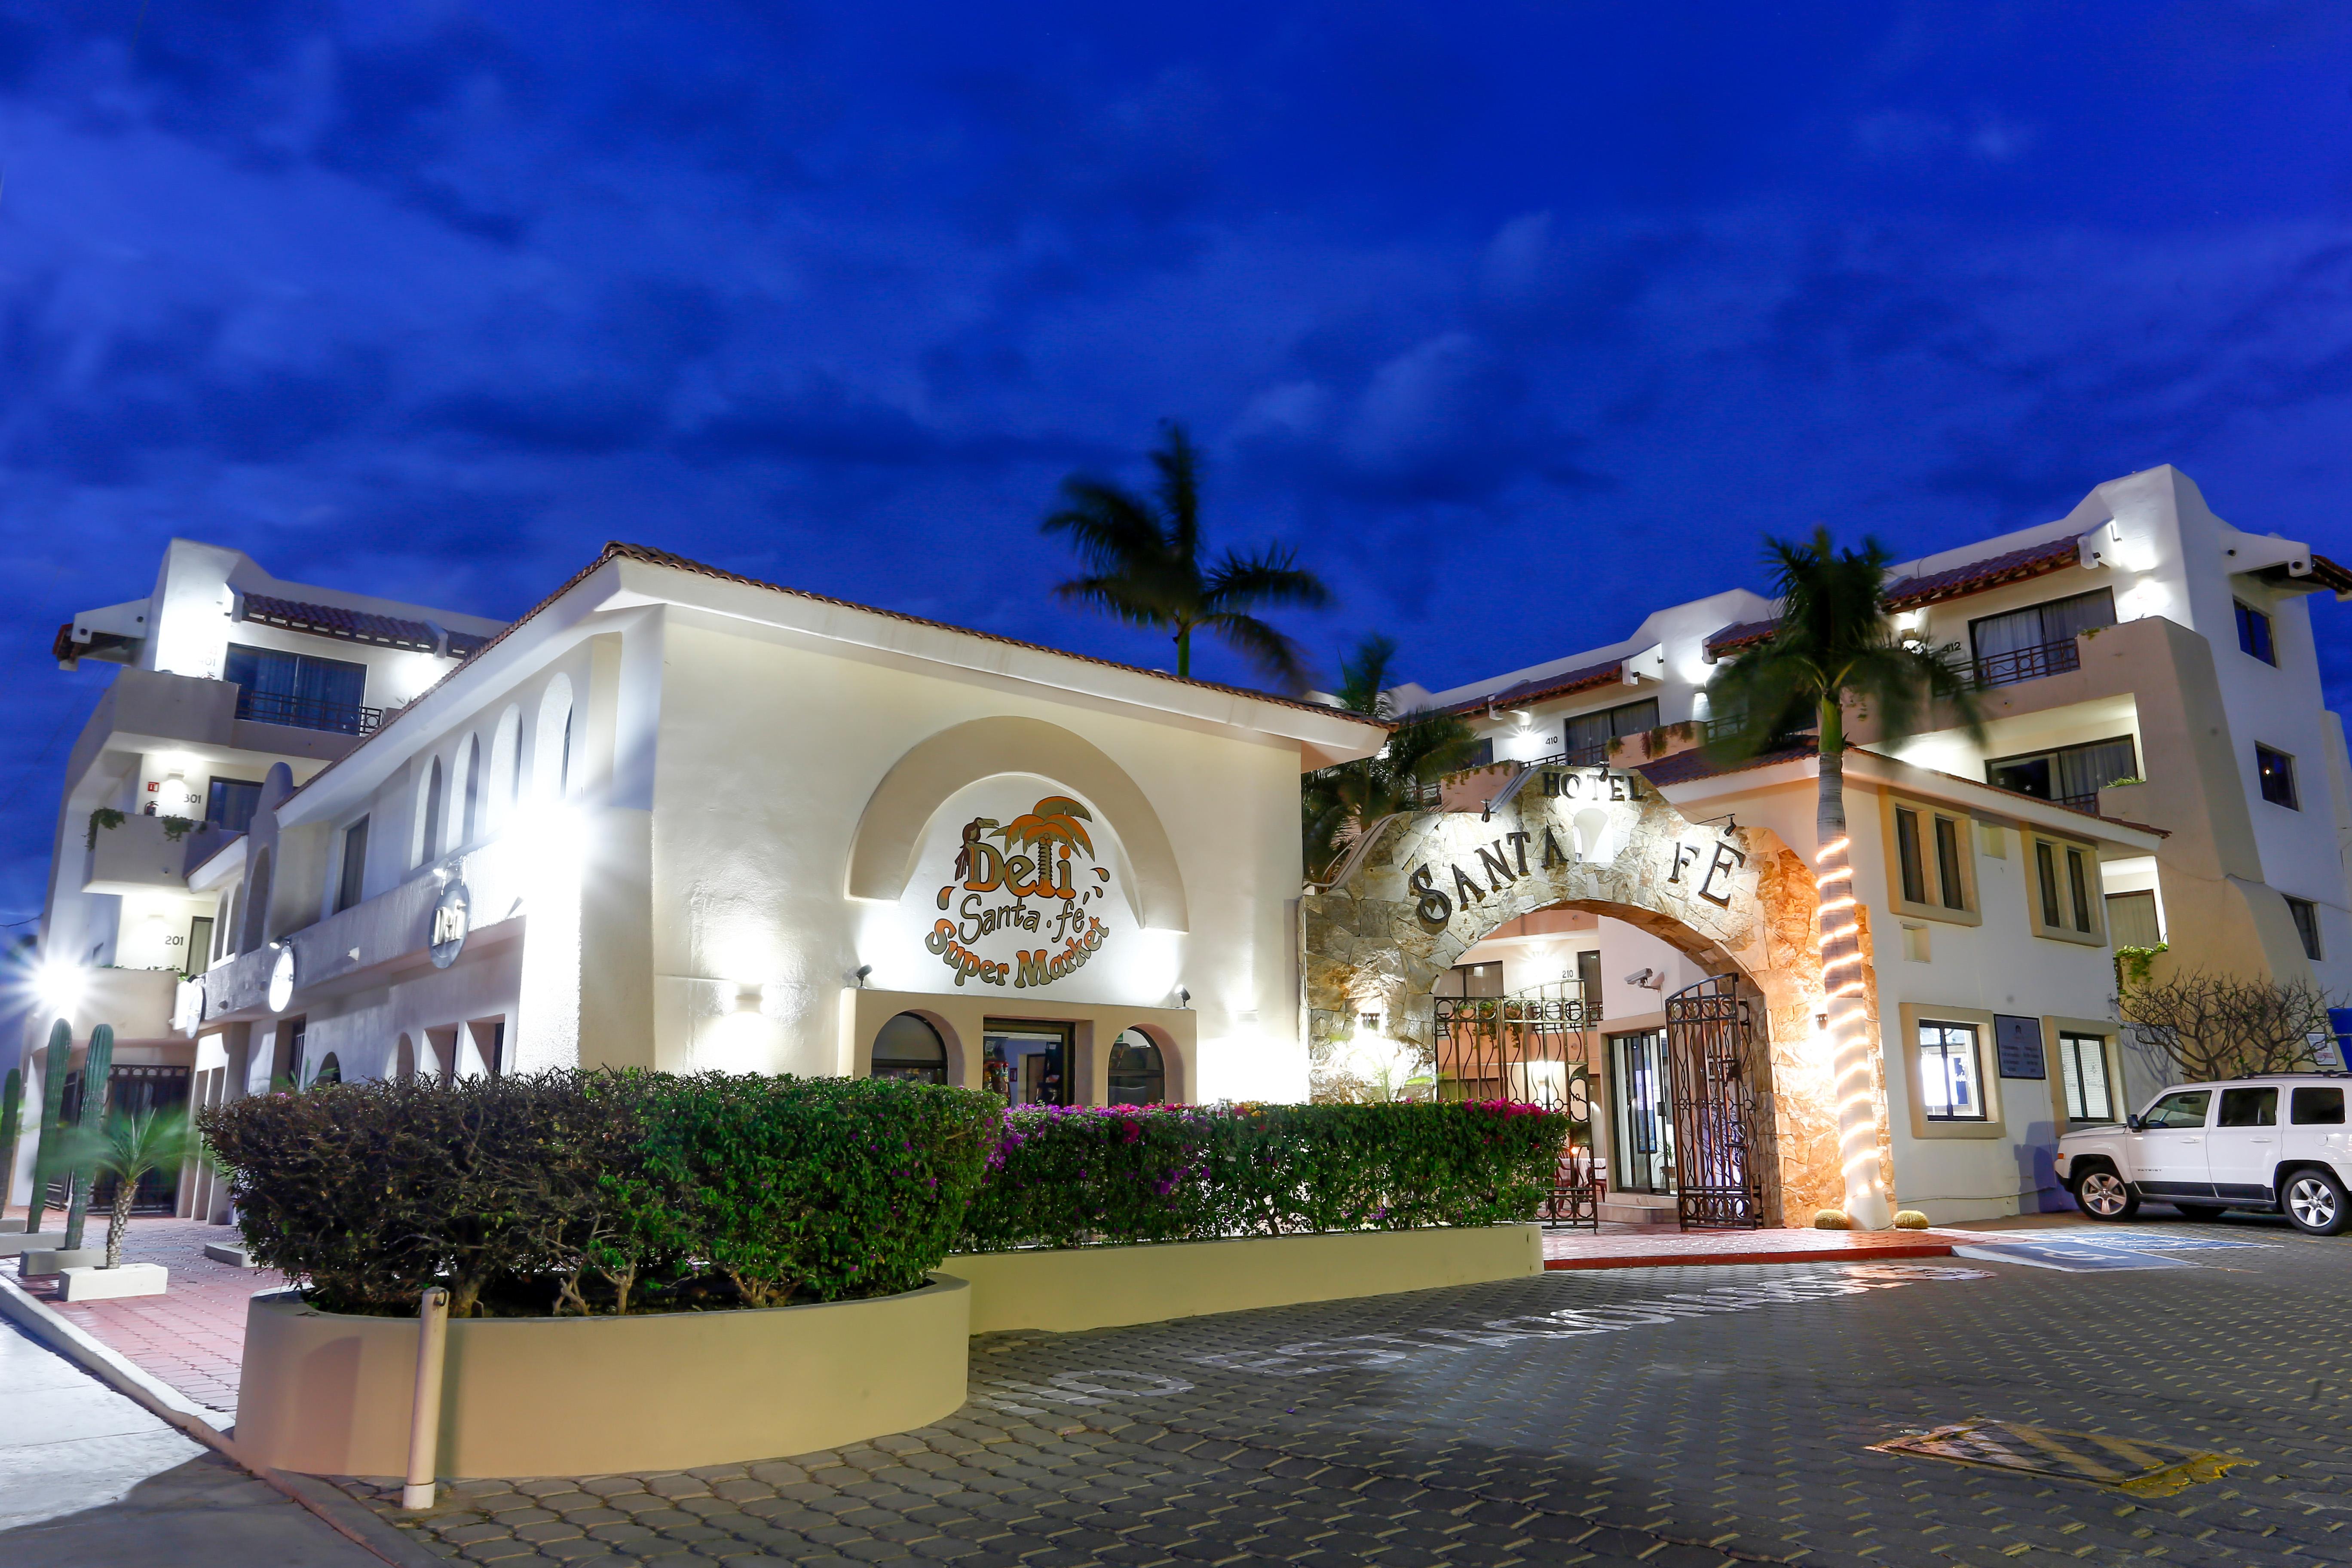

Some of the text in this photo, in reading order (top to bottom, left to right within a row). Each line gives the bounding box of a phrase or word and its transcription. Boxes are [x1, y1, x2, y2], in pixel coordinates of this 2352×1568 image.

[1942, 642, 1961, 653] 412
[1545, 736, 1558, 745] 410
[1543, 772, 1648, 801] HOTEL
[184, 793, 201, 804] 301
[963, 840, 1076, 899] Deli
[1412, 824, 1747, 924] SANTA FE
[958, 893, 1041, 945] Santa
[165, 935, 184, 946] 201
[925, 916, 1109, 989] Super Market
[1562, 970, 1573, 978] 210
